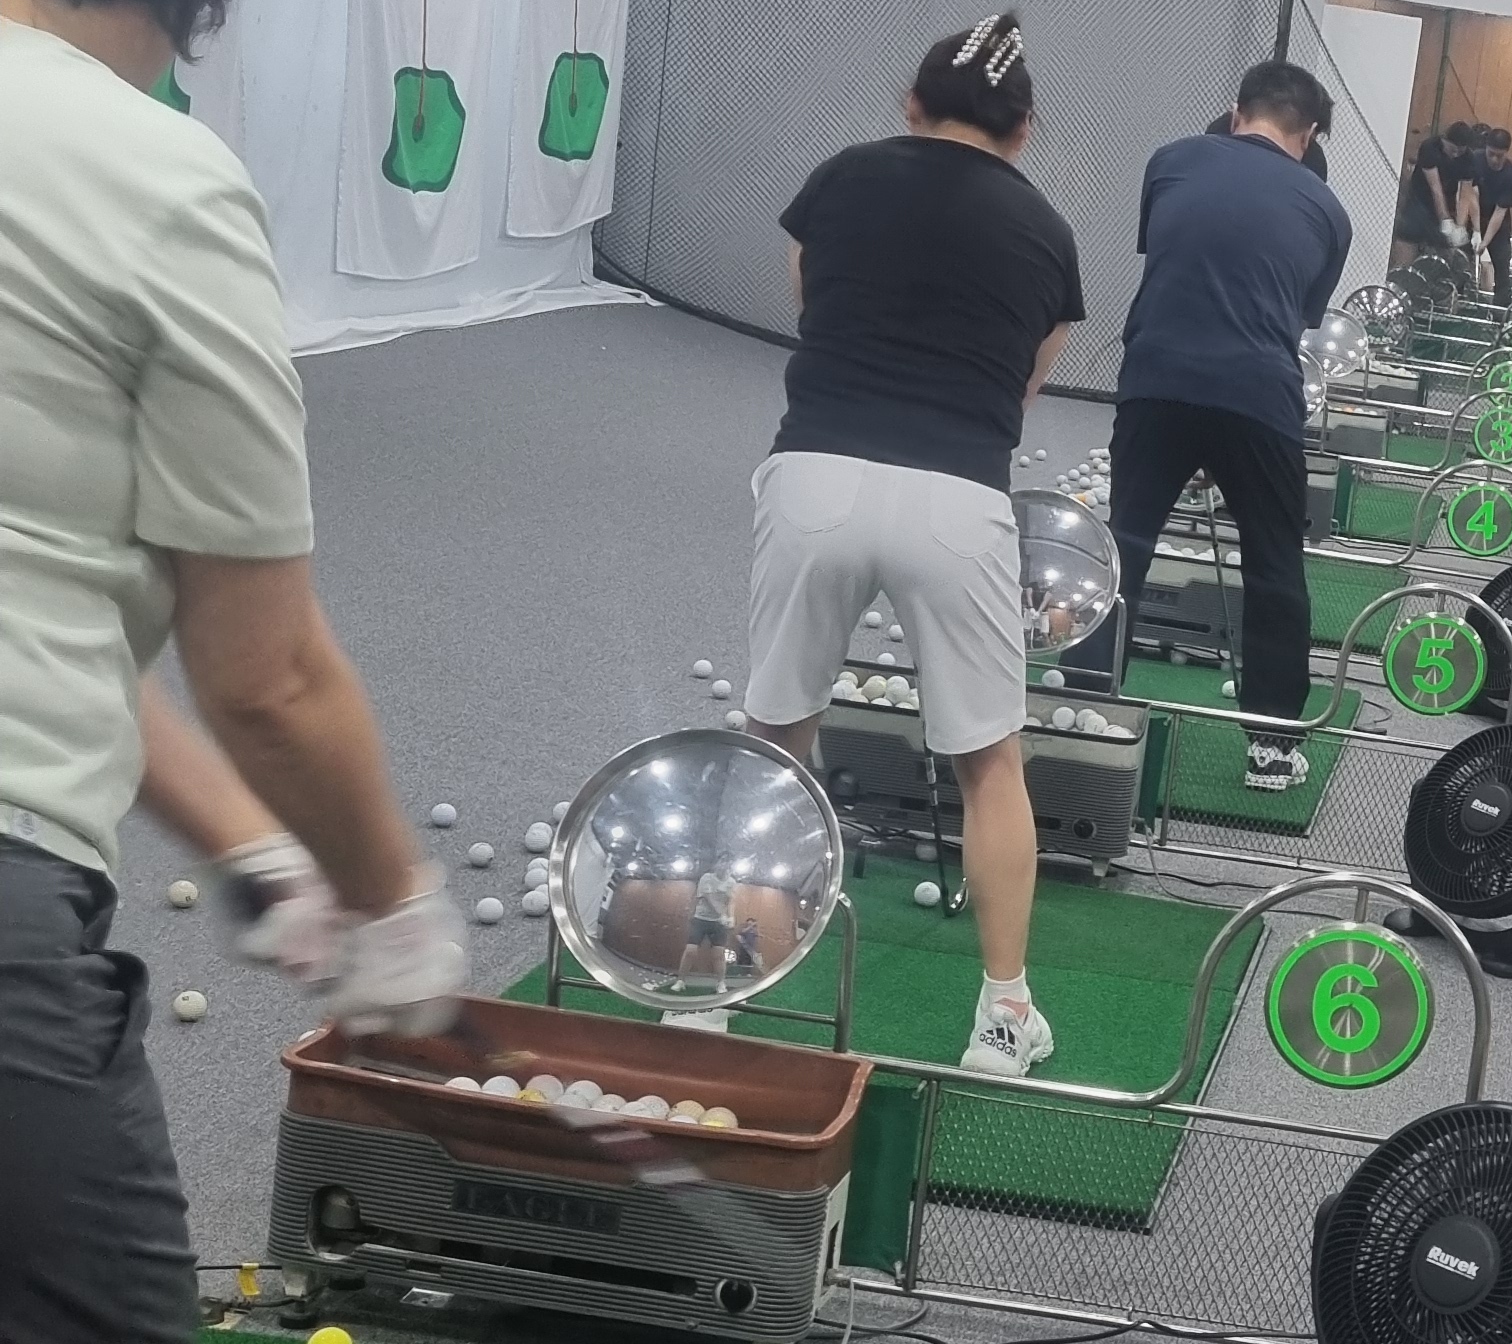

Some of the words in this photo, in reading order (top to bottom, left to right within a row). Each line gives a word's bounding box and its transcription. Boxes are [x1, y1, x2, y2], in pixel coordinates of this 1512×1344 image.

[1466, 500, 1498, 541] 4
[1412, 637, 1455, 694] 5
[1312, 963, 1381, 1054] 6
[979, 1033, 1017, 1058] adidas
[1426, 1245, 1480, 1278] Ruvek
